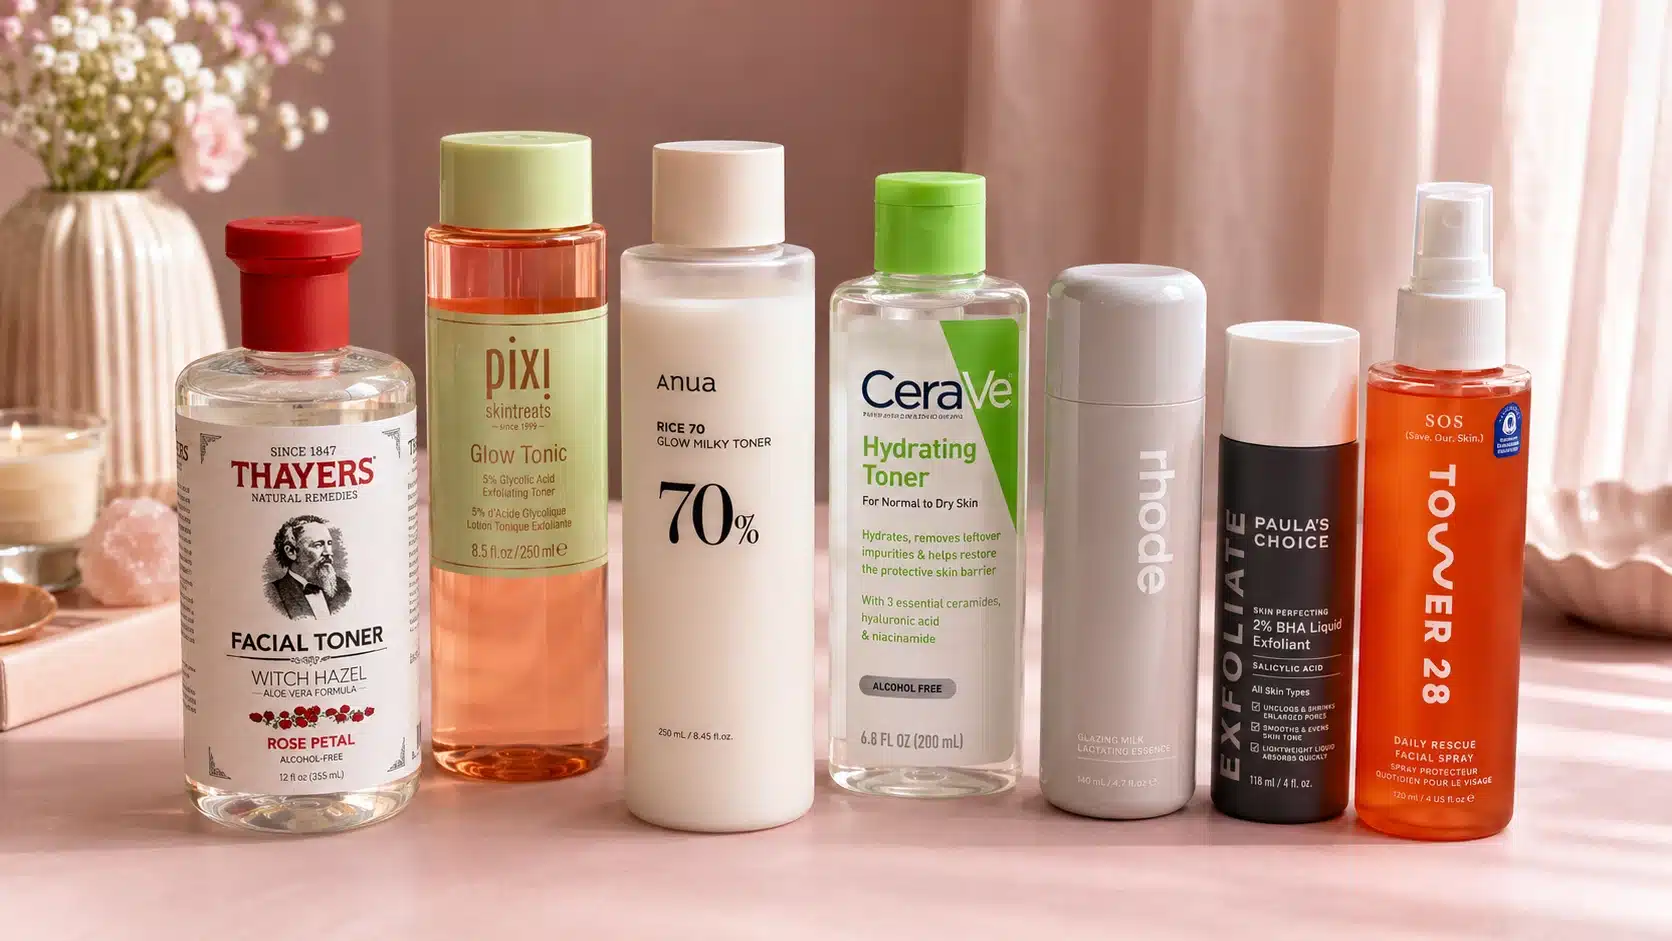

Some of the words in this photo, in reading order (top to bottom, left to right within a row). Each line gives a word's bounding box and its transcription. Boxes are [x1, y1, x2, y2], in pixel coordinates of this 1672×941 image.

[656, 374, 717, 392] Anua
[861, 369, 1013, 411] CeraVe
[486, 403, 551, 419] skintreats
[499, 422, 519, 431] since
[521, 422, 538, 431] 1999
[657, 421, 685, 434] RICE
[689, 423, 706, 434] 70
[1425, 414, 1463, 428] SOS
[657, 436, 690, 448] GLOW
[693, 439, 730, 449] MILKY
[733, 437, 772, 448] TONER
[1405, 431, 1432, 442] (Save.
[1435, 434, 1455, 443] Our.
[1457, 433, 1484, 443] Skin.)
[271, 447, 306, 457] SINCE
[311, 446, 337, 456] 1847
[471, 444, 515, 464] Glow
[520, 444, 567, 464] Tonic
[863, 435, 977, 464] Hydrating
[231, 457, 374, 489] THAYERS
[483, 474, 497, 485] 5%
[500, 474, 534, 487] Glycolic
[536, 473, 555, 484] Acid
[862, 464, 930, 488] Toner
[252, 493, 301, 503] NATURAL
[305, 490, 358, 503] REMEDIES
[483, 487, 528, 499] Exfoliating
[531, 487, 556, 497] Toner
[862, 496, 880, 507] For
[882, 497, 920, 508] Normal
[923, 499, 933, 508] to
[935, 499, 954, 510] Dry
[956, 498, 979, 508] Skin
[472, 507, 485, 518] 5%
[488, 508, 520, 519] d'Acide
[522, 506, 567, 520] Glycolique
[659, 481, 760, 546] 70%
[467, 519, 493, 531] Lotion
[495, 521, 529, 533] Tonique
[532, 519, 573, 531] Exfoliante
[1137, 450, 1176, 594] rhode
[1255, 516, 1330, 532] PAULA'S
[862, 529, 912, 544] Hydrates,
[914, 533, 961, 543] removes
[963, 531, 1002, 542] leftover
[1254, 534, 1329, 549] CHOICE
[472, 543, 488, 558] 8.5
[862, 546, 915, 560] impurities
[917, 550, 926, 560] &
[928, 550, 958, 562] helps
[960, 549, 997, 559] restore
[1424, 464, 1457, 643] TOWER
[862, 564, 878, 575] the
[881, 566, 933, 577] protective
[936, 567, 958, 577] skin
[961, 565, 997, 577] barrier
[862, 595, 885, 607] With
[887, 597, 894, 607] 3
[896, 598, 944, 609] essential
[946, 596, 1001, 609] ceramides,
[1254, 606, 1273, 615] SKIN
[1276, 608, 1329, 617] PERFECTING
[861, 613, 916, 626] hyaluronic
[918, 616, 940, 627] acid
[1253, 618, 1273, 633] 2%
[1276, 621, 1306, 634] BHA
[1310, 618, 1343, 635] Liquid
[231, 632, 309, 652] FACIAL
[314, 626, 383, 650] TONER
[861, 630, 870, 641] &
[872, 632, 936, 645] niacinamide
[1253, 636, 1311, 651] Exfoliant
[1220, 509, 1246, 782] EXFOLIATE
[1252, 661, 1300, 673] SALICYLIC
[251, 670, 309, 687] WITCH
[315, 666, 367, 685] HAZEL
[1422, 658, 1451, 704] 28
[263, 689, 287, 698] ALOE
[288, 689, 312, 697] VERA
[315, 686, 357, 697] FORMULA
[873, 682, 916, 693] ALCOHOL
[918, 684, 943, 693] FREE
[1252, 685, 1263, 694] All
[1265, 687, 1284, 696] Skin
[1286, 688, 1311, 698] Types
[1263, 704, 1299, 712] UNCLOGS
[658, 727, 672, 738] 250
[673, 731, 686, 739] mL
[693, 731, 712, 740] 8.45
[1263, 725, 1300, 733] SMOOTHS
[268, 738, 306, 750] ROSE
[311, 734, 355, 748] PETAL
[861, 730, 877, 746] 6.8
[881, 732, 894, 747] FL
[897, 734, 911, 748] OZ
[914, 733, 939, 749] (200
[942, 733, 964, 750] mL)
[1077, 732, 1119, 744] GLAZING
[1121, 735, 1144, 745] MILK
[1394, 736, 1427, 749] DAILY
[1431, 740, 1476, 749] RESCUE
[1077, 744, 1129, 756] LACTATING
[1131, 744, 1172, 756] ESSENCE
[1263, 745, 1313, 753] LIGHTWEIGHT
[1314, 744, 1336, 753] LIQUID
[280, 753, 343, 764] ALCOHOL-FREE
[1299, 754, 1328, 762] QUICKLY
[1395, 750, 1434, 762] FACIAL
[1438, 754, 1474, 763] SPRAY
[279, 772, 288, 782] 12
[290, 772, 296, 781] fl
[309, 771, 327, 783] (355
[329, 770, 345, 780] mL)
[1390, 763, 1417, 773] SPRAY
[1420, 767, 1478, 777] PROTECTEUR
[1077, 776, 1091, 785] 140
[1250, 775, 1262, 786] 118
[1265, 777, 1275, 788] ml
[1283, 778, 1289, 788] 4
[1376, 770, 1421, 785] QUOTIDIEN
[1423, 779, 1449, 787] POUR
[1451, 779, 1461, 787] LE
[1464, 776, 1492, 786] VISAGE
[1434, 795, 1445, 803] US
